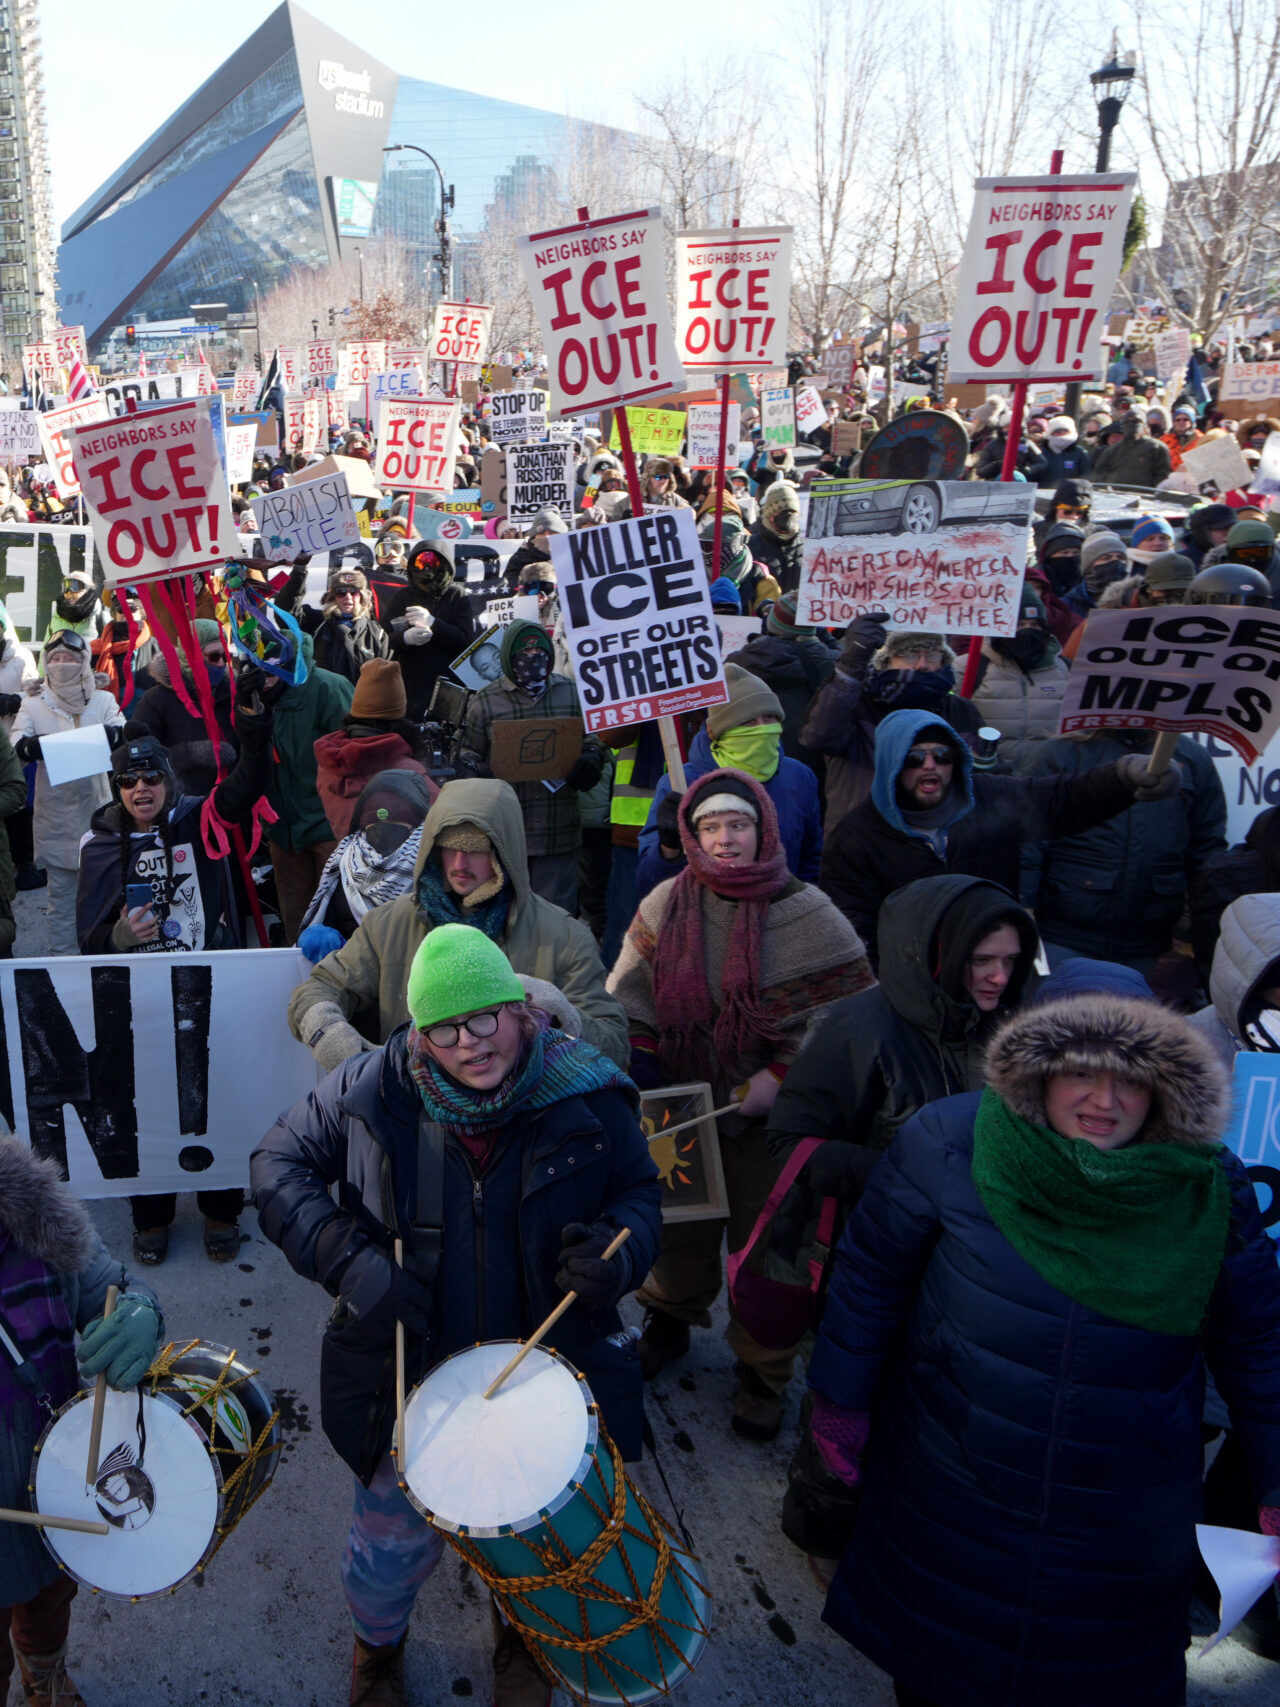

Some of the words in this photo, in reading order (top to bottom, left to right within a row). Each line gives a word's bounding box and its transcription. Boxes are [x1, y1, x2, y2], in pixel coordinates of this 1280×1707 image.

[335, 91, 384, 119] stadium
[989, 202, 1083, 224] NEIGHBORS
[1086, 204, 1118, 221] SAY
[534, 237, 617, 269] NEIGHBORS
[621, 229, 647, 248] SAY
[688, 251, 752, 266] NEIGHBORS
[756, 251, 778, 263] SAY
[976, 229, 1104, 298] ICE
[542, 255, 646, 331] ICE
[688, 268, 770, 311] ICE
[440, 316, 482, 339] ICE
[685, 316, 775, 357] OUT!
[968, 305, 1097, 370] OUT!
[28, 353, 51, 365] ICE
[309, 346, 331, 360] ICE
[437, 337, 481, 360] OUT!
[558, 323, 659, 396] OUT!
[825, 350, 851, 366] NO
[309, 360, 333, 373] OUT!
[822, 367, 851, 382] ICE
[236, 380, 255, 389] ICE
[376, 373, 411, 393] ICE
[492, 394, 526, 416] STOP
[767, 389, 790, 402] ICE
[389, 407, 435, 419] NEIGHBORS
[437, 408, 452, 418] SAY
[387, 419, 446, 452] ICE
[492, 420, 502, 430] ICE
[493, 427, 527, 436] NOW!
[4, 438, 15, 449] AT
[80, 424, 168, 459] NEIGHBORS
[171, 419, 198, 438] SAY
[510, 443, 570, 454] ARREST
[382, 452, 448, 486] OUT!
[513, 452, 567, 469] JONATHAN
[88, 443, 207, 515] ICE
[517, 468, 543, 483] ROSS
[544, 467, 564, 481] FOR
[515, 483, 567, 504] MURDER
[260, 479, 352, 533] ABOLISH
[50, 513, 64, 522] ICE
[107, 504, 220, 568] OUT!
[292, 518, 341, 553] ICE
[569, 514, 683, 581] KILLER
[565, 559, 703, 629] ICE
[817, 578, 877, 601] TRUMP
[880, 575, 952, 600] SHEDS
[961, 583, 1009, 604] OUR
[489, 600, 515, 613] FUCK
[498, 612, 515, 622] ICE
[893, 607, 928, 626] ON
[941, 602, 1009, 628] THEE
[577, 628, 640, 657] OFF
[647, 615, 710, 642] OUR
[1122, 616, 1280, 651] ICE
[1087, 647, 1214, 669] OUT
[579, 635, 718, 706] STREETS
[1079, 675, 1273, 733] MPLS
[137, 856, 166, 873] OUT
[166, 939, 178, 948] ON
